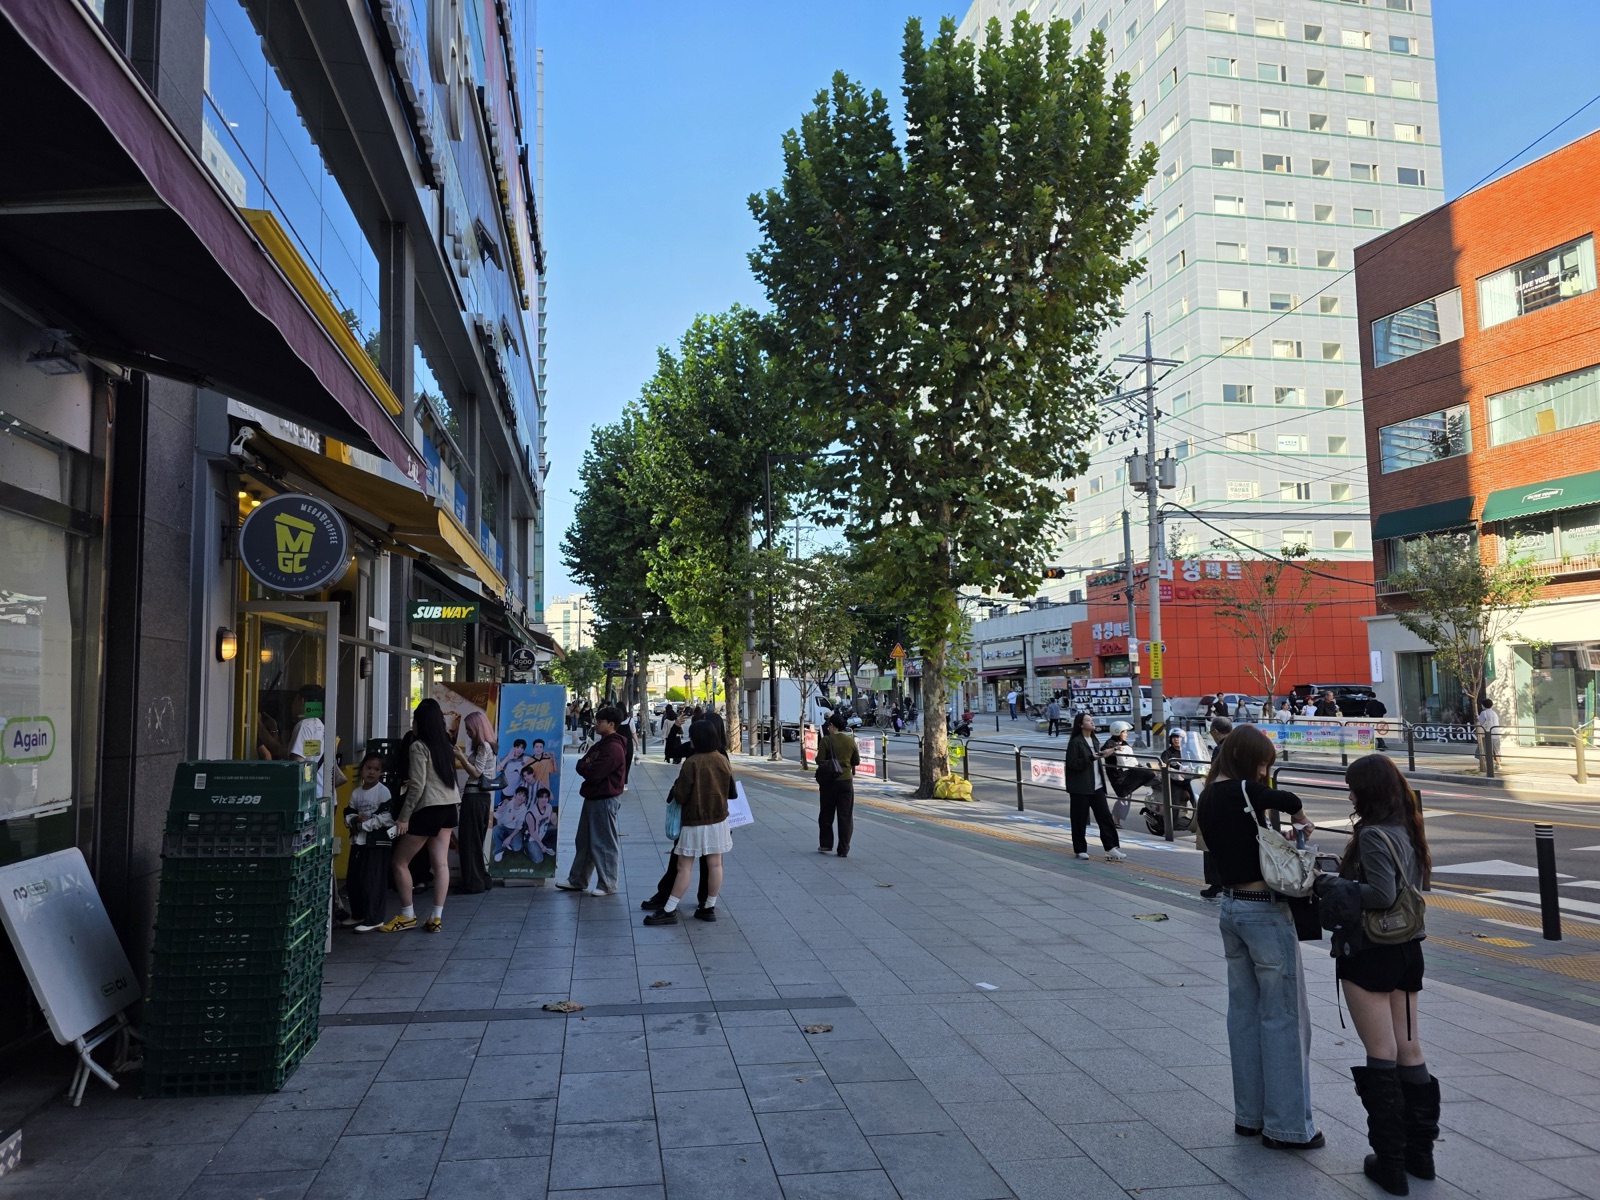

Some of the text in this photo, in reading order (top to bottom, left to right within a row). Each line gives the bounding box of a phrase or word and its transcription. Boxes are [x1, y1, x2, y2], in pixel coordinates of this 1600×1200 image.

[303, 427, 320, 454] SIZE
[300, 503, 338, 544] MEGA COFFEE
[413, 605, 475, 619] SUBWAY
[511, 700, 551, 719] 승리를
[13, 728, 47, 752] Again
[1413, 722, 1479, 743] ongtak
